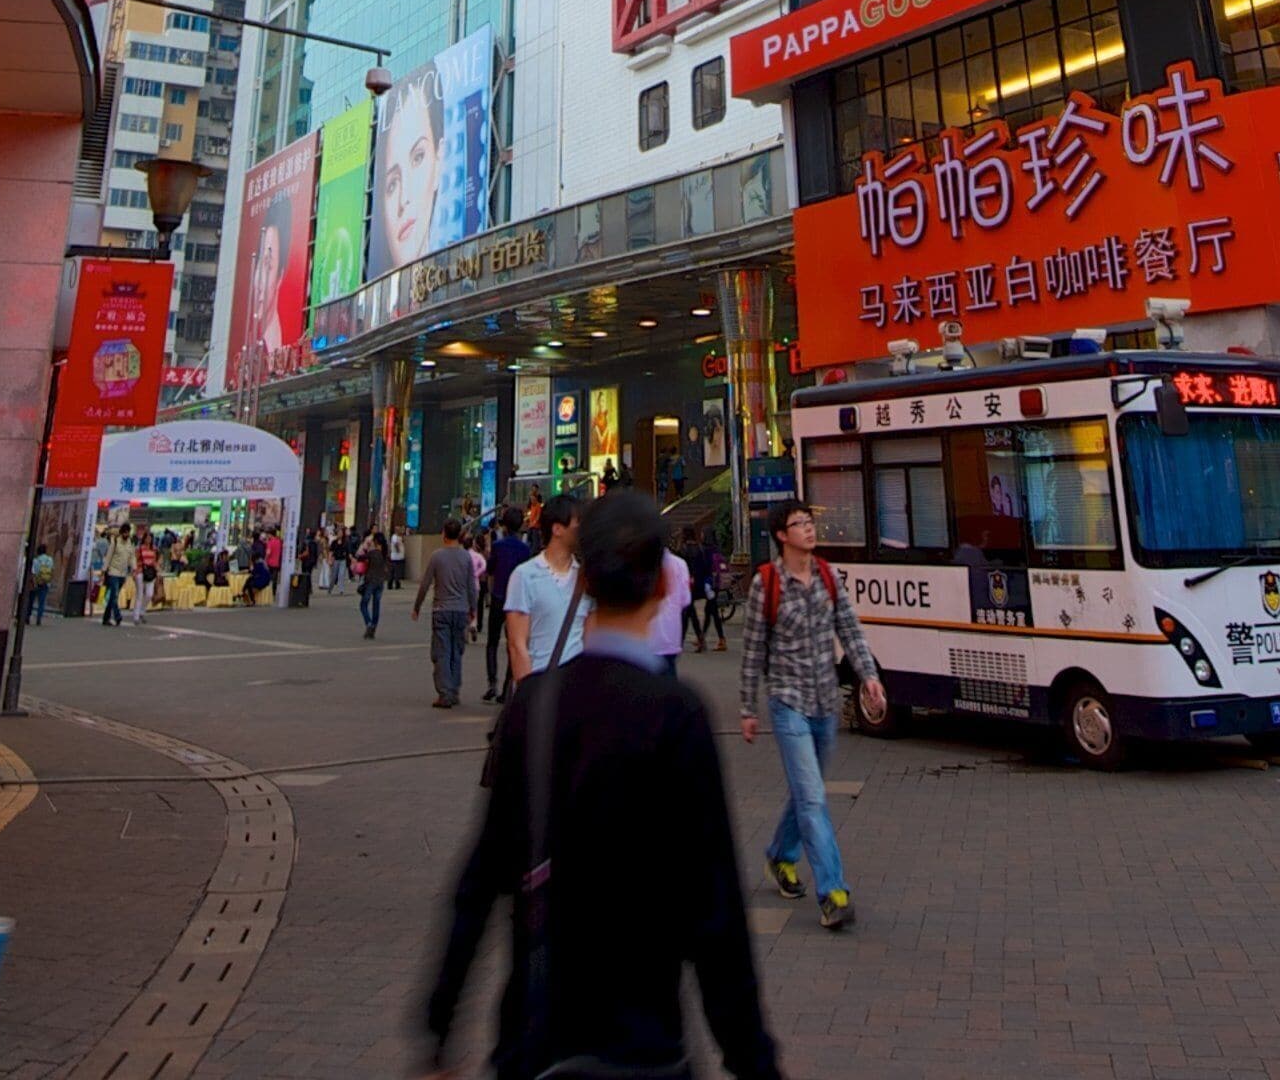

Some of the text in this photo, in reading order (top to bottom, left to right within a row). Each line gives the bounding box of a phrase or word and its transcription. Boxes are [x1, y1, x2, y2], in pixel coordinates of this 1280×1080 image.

[856, 70, 1234, 258] 帕帕珍味
[858, 217, 1233, 328] 马来西亚白咖啡餐厅
[875, 392, 1002, 428] 越秀公安
[855, 578, 931, 608] POLICE
[1225, 621, 1255, 665] 警
